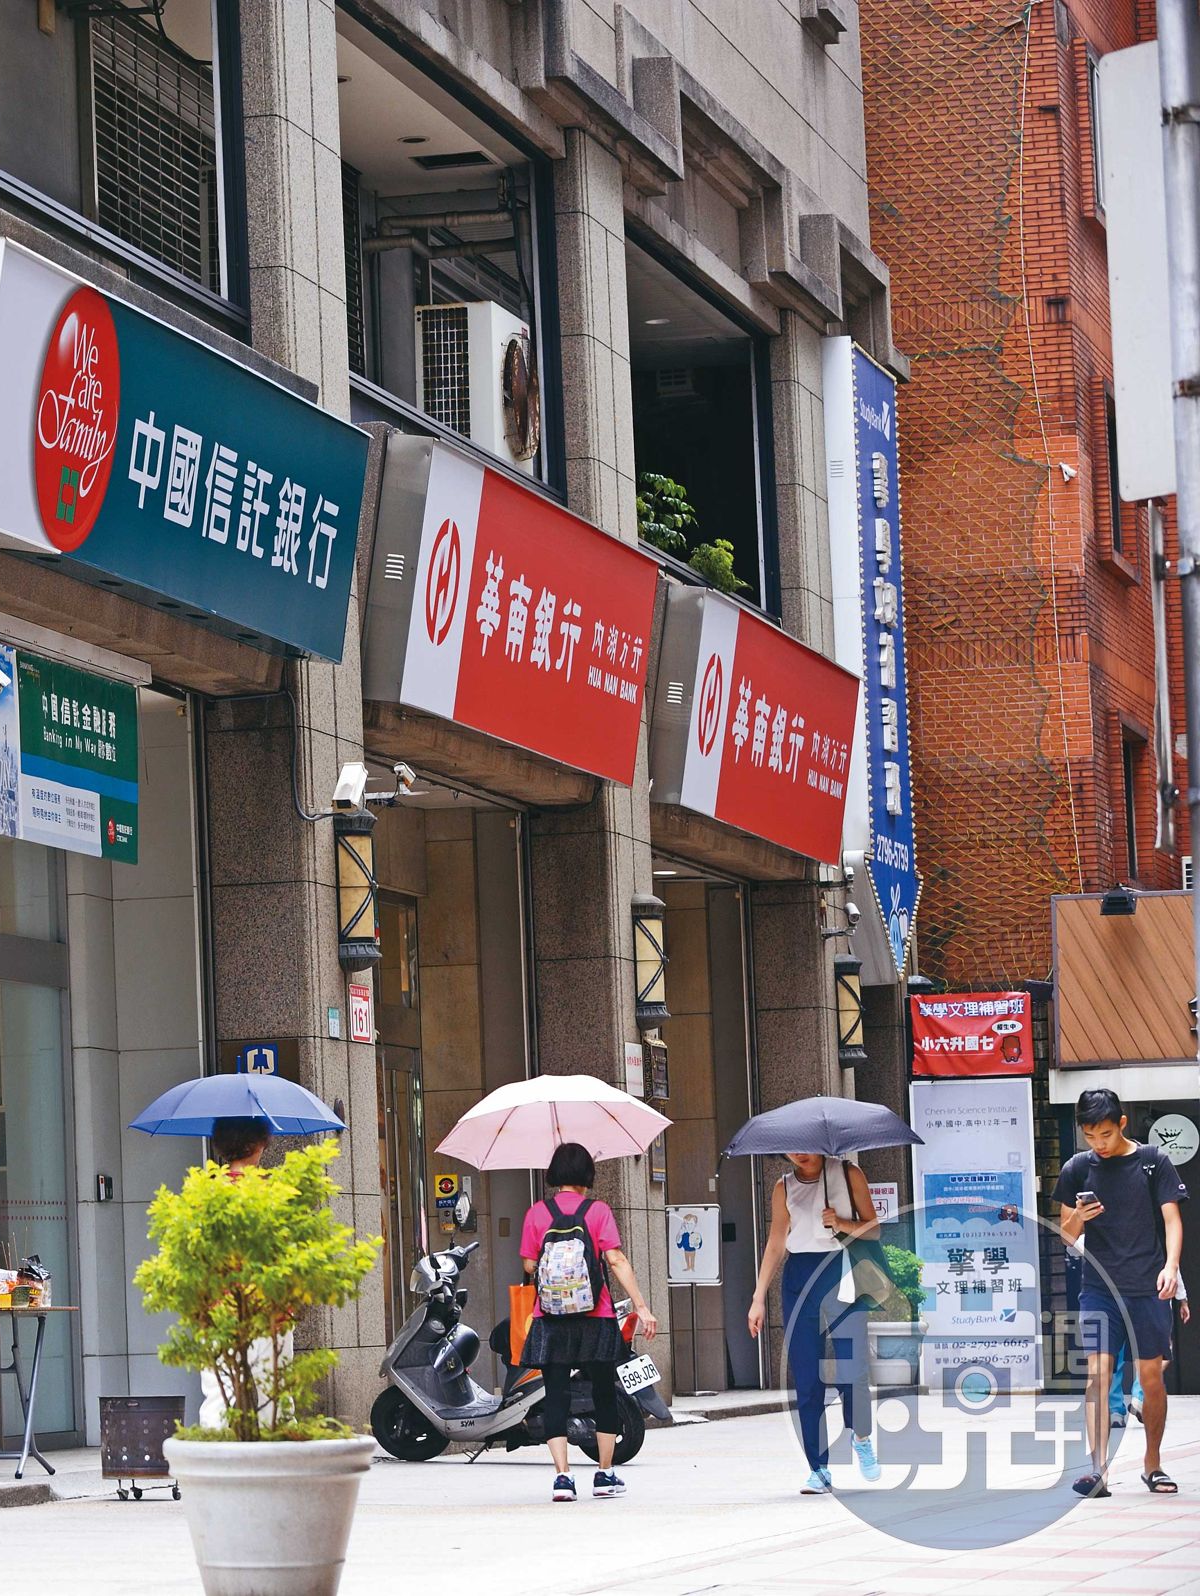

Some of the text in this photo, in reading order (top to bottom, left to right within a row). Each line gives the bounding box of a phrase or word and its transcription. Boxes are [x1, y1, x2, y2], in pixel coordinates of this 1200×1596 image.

[73, 319, 99, 379] We
[38, 370, 118, 497] Family
[127, 410, 340, 590] 中國信託銀行
[474, 549, 583, 683] 華南銀行
[591, 618, 643, 675] 內湖分行
[587, 664, 637, 705] HUA NAN BANK
[43, 726, 97, 757] Banking in My Way
[731, 675, 806, 784] 華南銀行
[810, 729, 848, 775] 內湖分行
[807, 768, 843, 800] HUA NAN BANK
[876, 833, 910, 873] 2796-5759
[354, 1007, 369, 1033] 161
[921, 1035, 994, 1052] 小六升國七
[947, 1246, 1010, 1276] 擎學
[936, 1278, 1023, 1296] 文理補習班
[952, 1314, 998, 1325] StudyBank
[952, 1338, 1029, 1350] 02-2792-6615
[953, 1354, 1030, 1364] 02-2796-5759
[621, 1363, 658, 1389] 599-JZR
